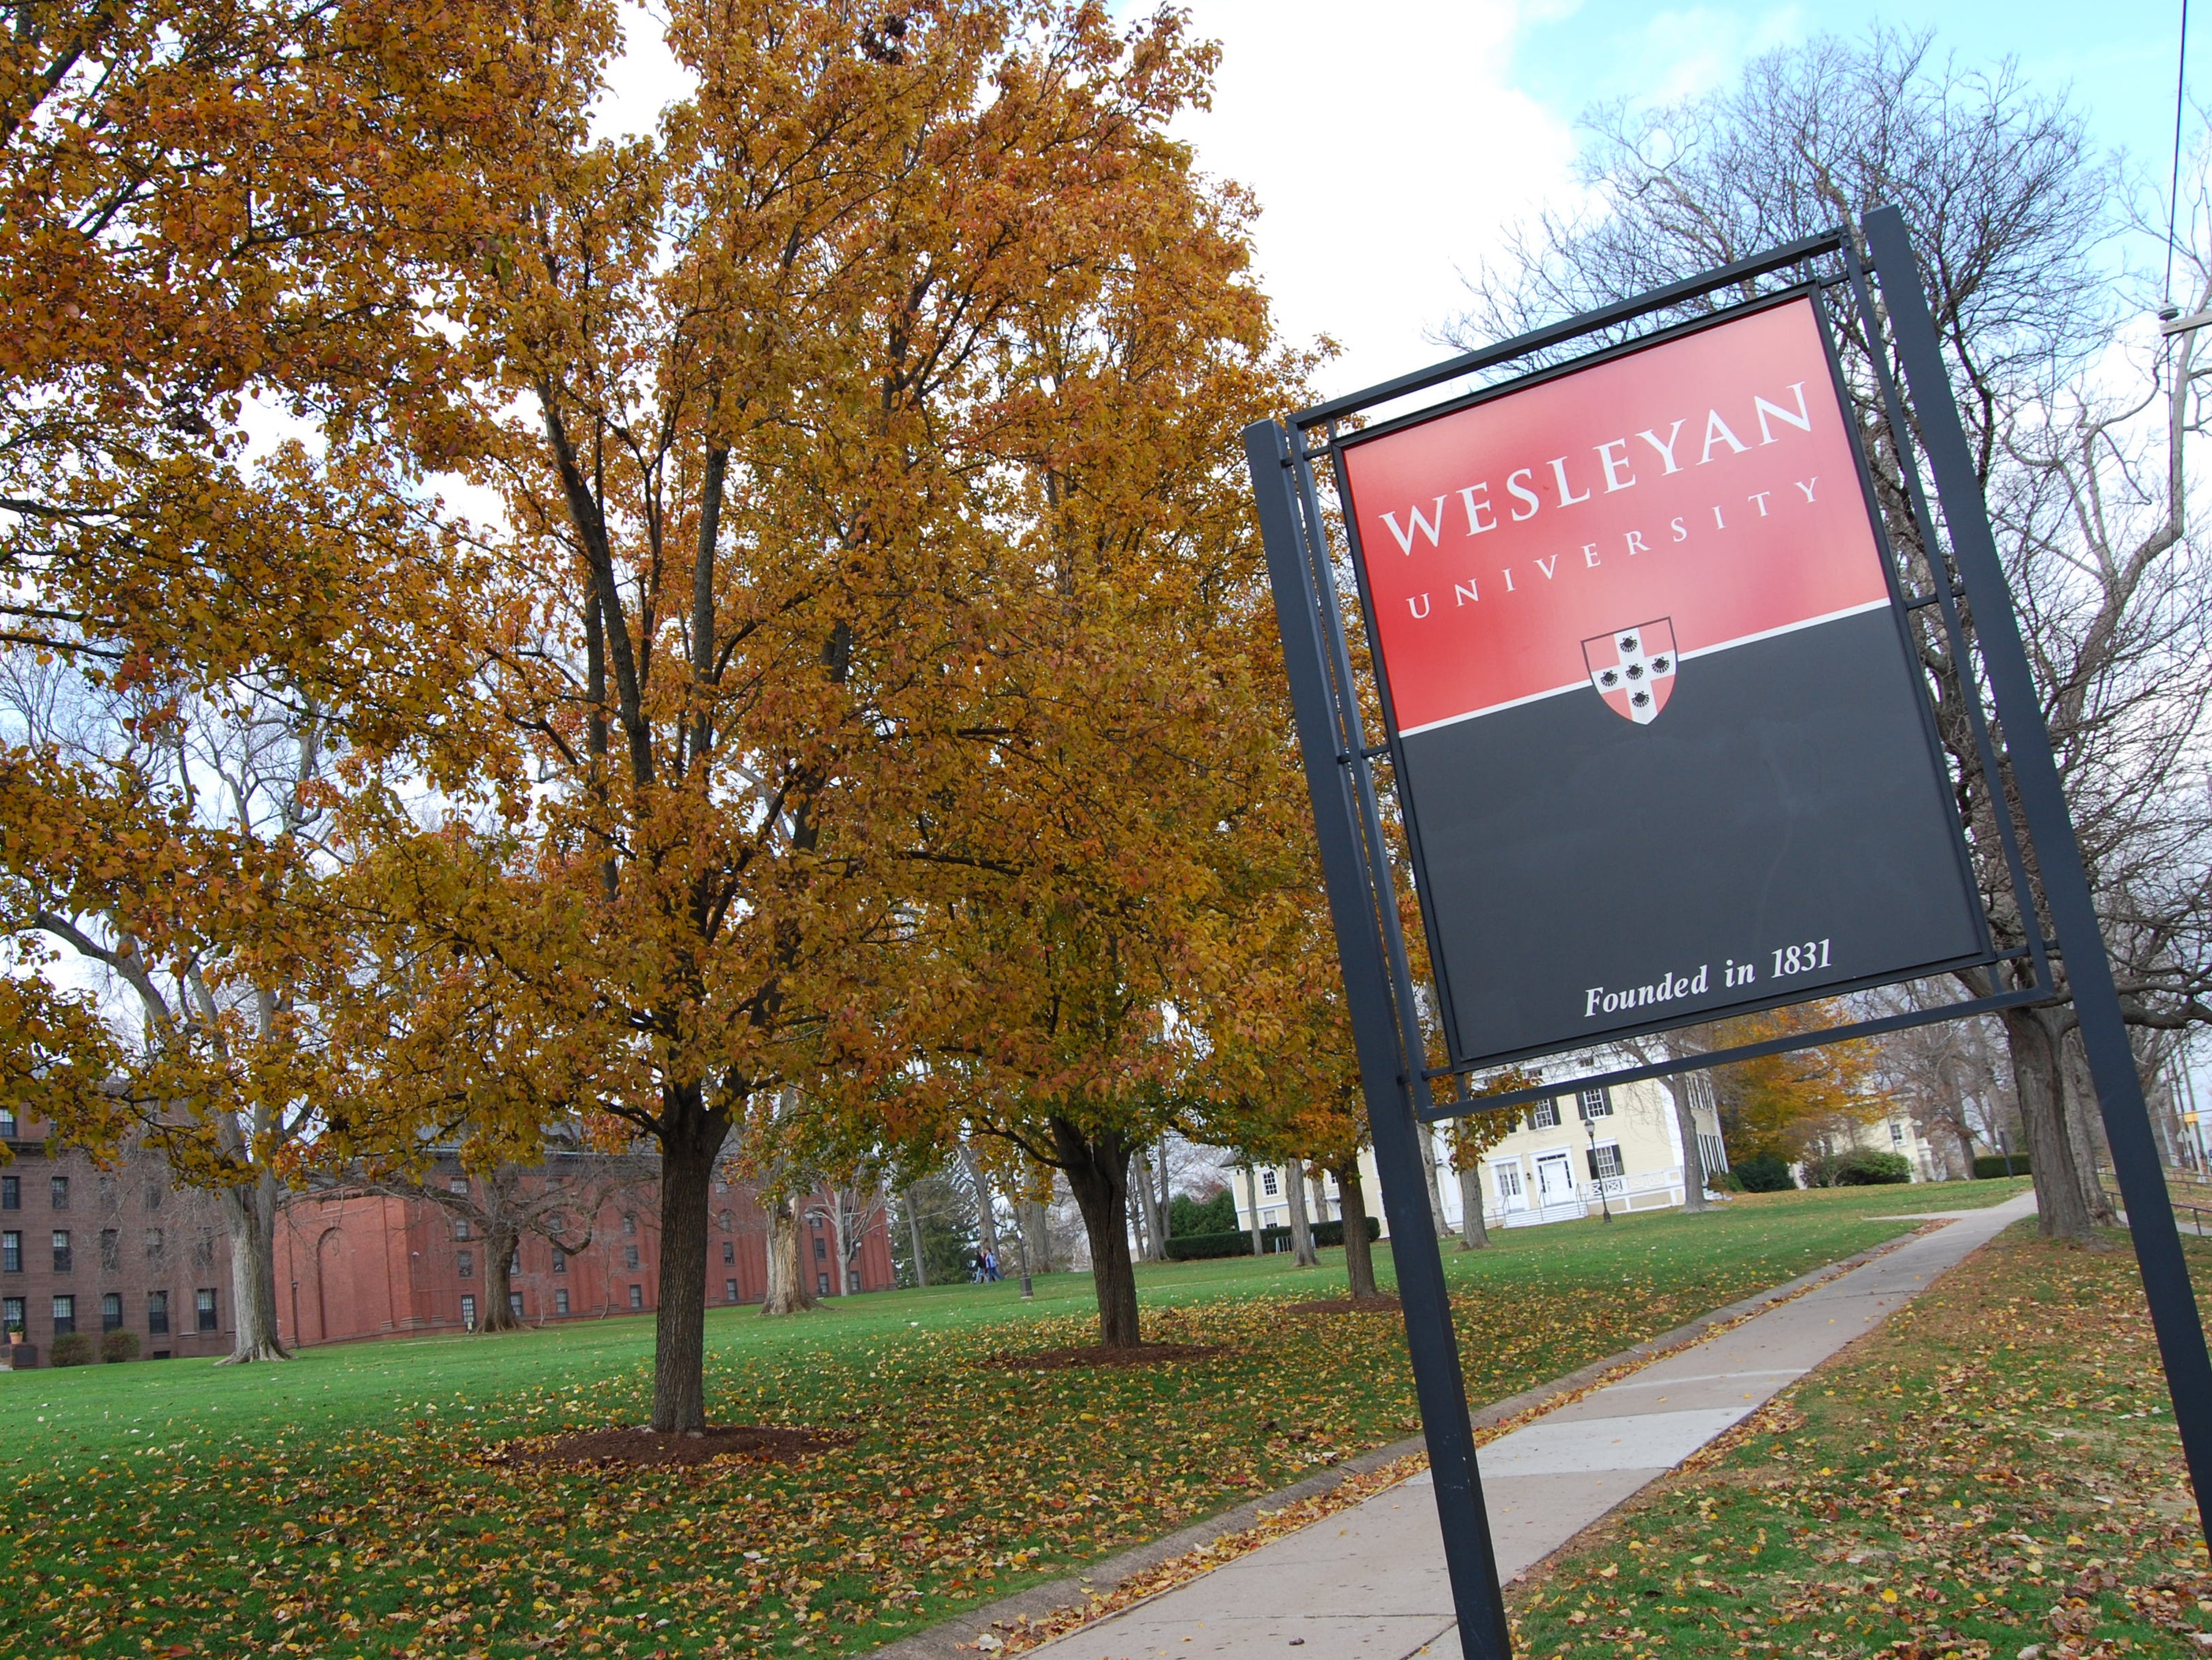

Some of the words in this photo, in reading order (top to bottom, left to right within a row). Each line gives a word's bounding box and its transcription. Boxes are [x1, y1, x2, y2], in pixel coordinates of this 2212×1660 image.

[1378, 381, 1811, 556] WESLEYAN
[1406, 476, 1819, 619] UNIVERSITY
[1584, 964, 1709, 1017] Founded
[1724, 959, 1755, 988] in
[1770, 938, 1832, 979] 1831
